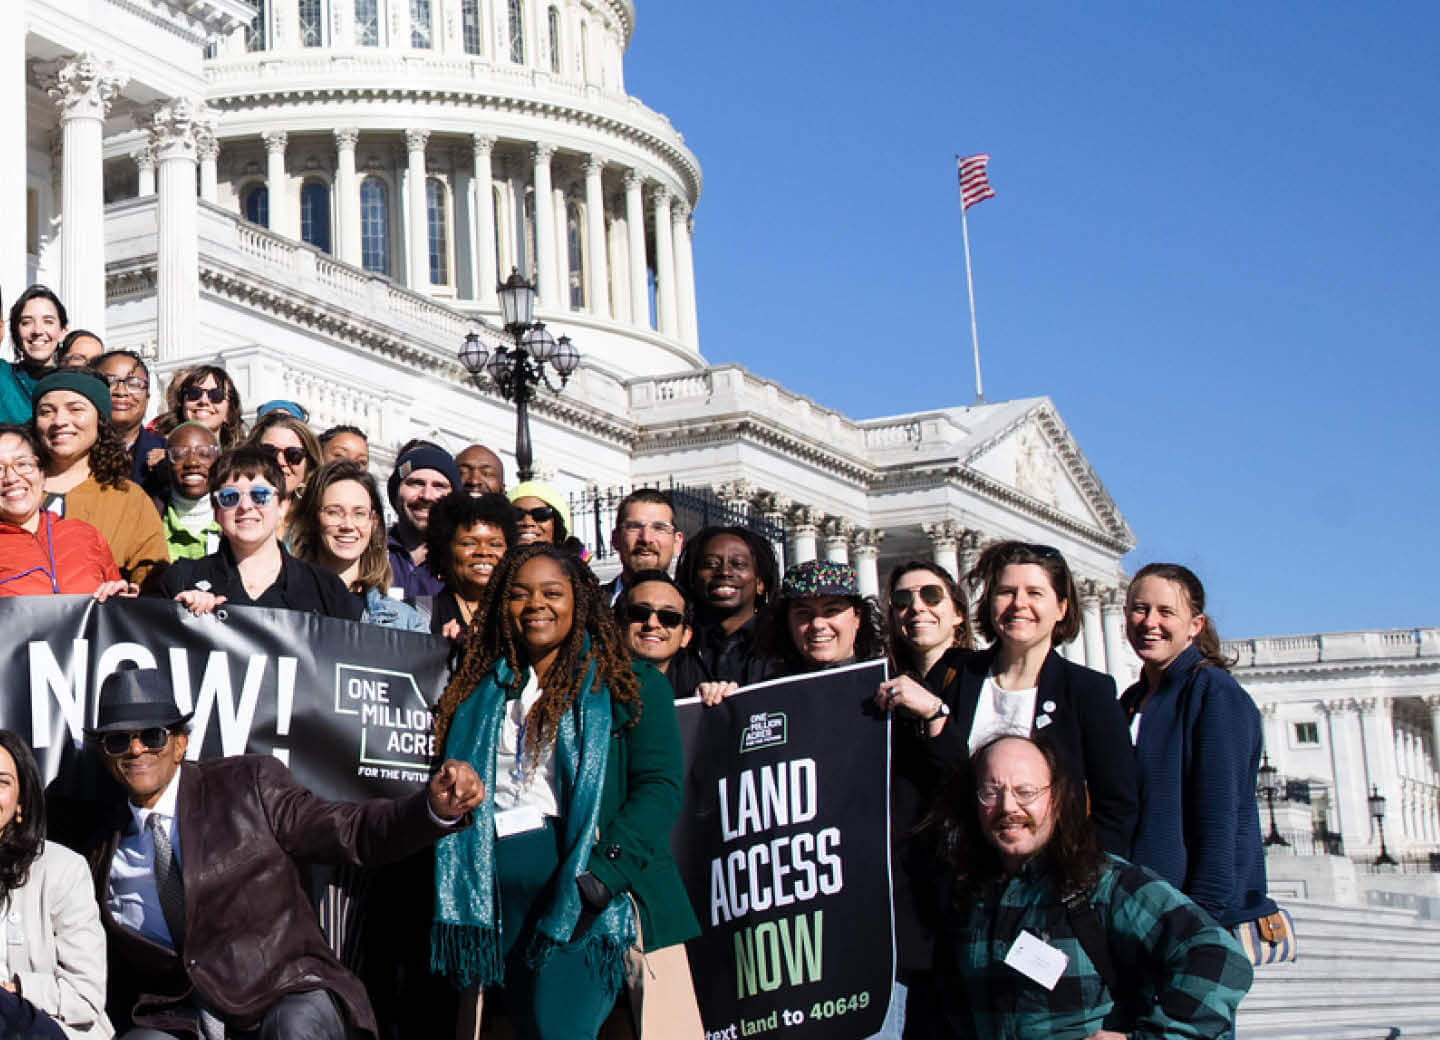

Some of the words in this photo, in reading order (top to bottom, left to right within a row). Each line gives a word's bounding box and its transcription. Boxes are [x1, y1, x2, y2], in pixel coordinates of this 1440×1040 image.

[348, 678, 390, 703] ONE
[386, 731, 437, 756] ACRE
[358, 765, 378, 778] FOR
[381, 768, 400, 780] THE
[718, 758, 818, 843] LAND
[711, 826, 843, 928] ACCESS
[734, 910, 824, 1000] NOW
[740, 1010, 778, 1037] land
[782, 1008, 805, 1026] to
[810, 991, 871, 1021] 40649
